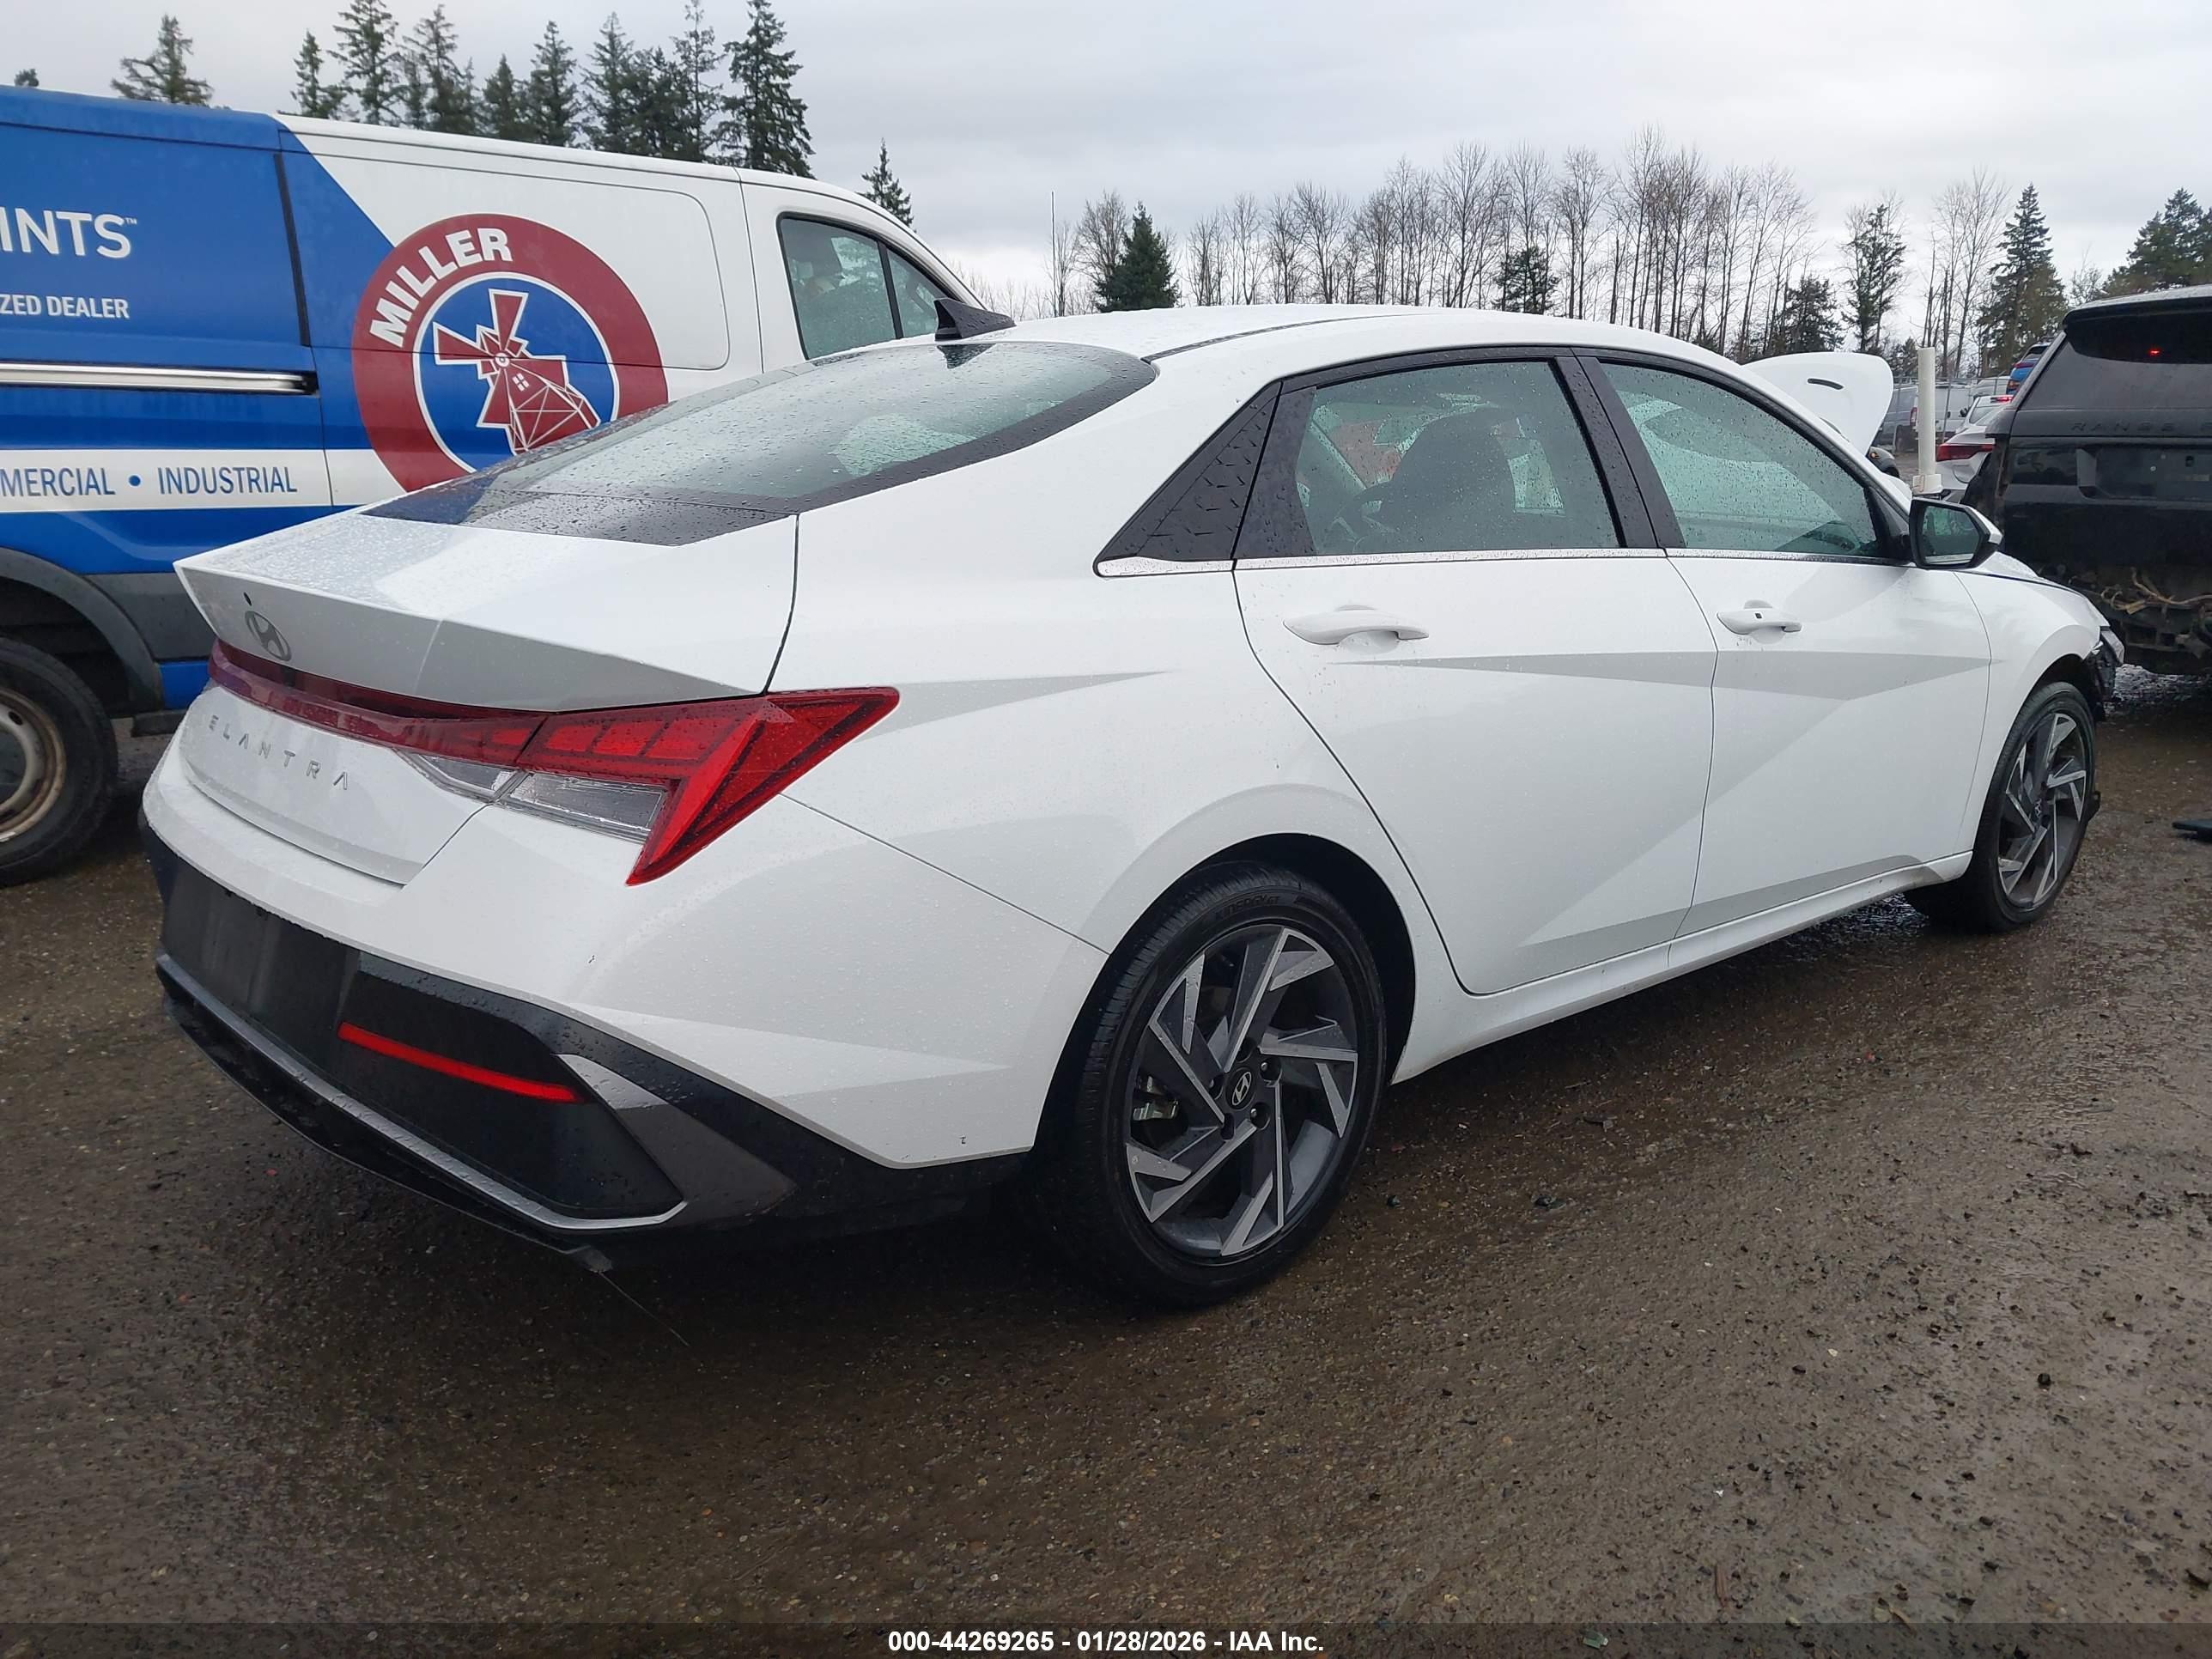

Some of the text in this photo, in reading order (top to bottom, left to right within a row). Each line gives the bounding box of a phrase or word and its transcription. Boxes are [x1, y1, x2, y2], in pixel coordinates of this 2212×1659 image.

[46, 295, 130, 319] DEALER
[369, 228, 514, 348] MILLER
[0, 466, 297, 497] MERCIAL INDUSTRIAL
[210, 714, 349, 791] ELANTRA
